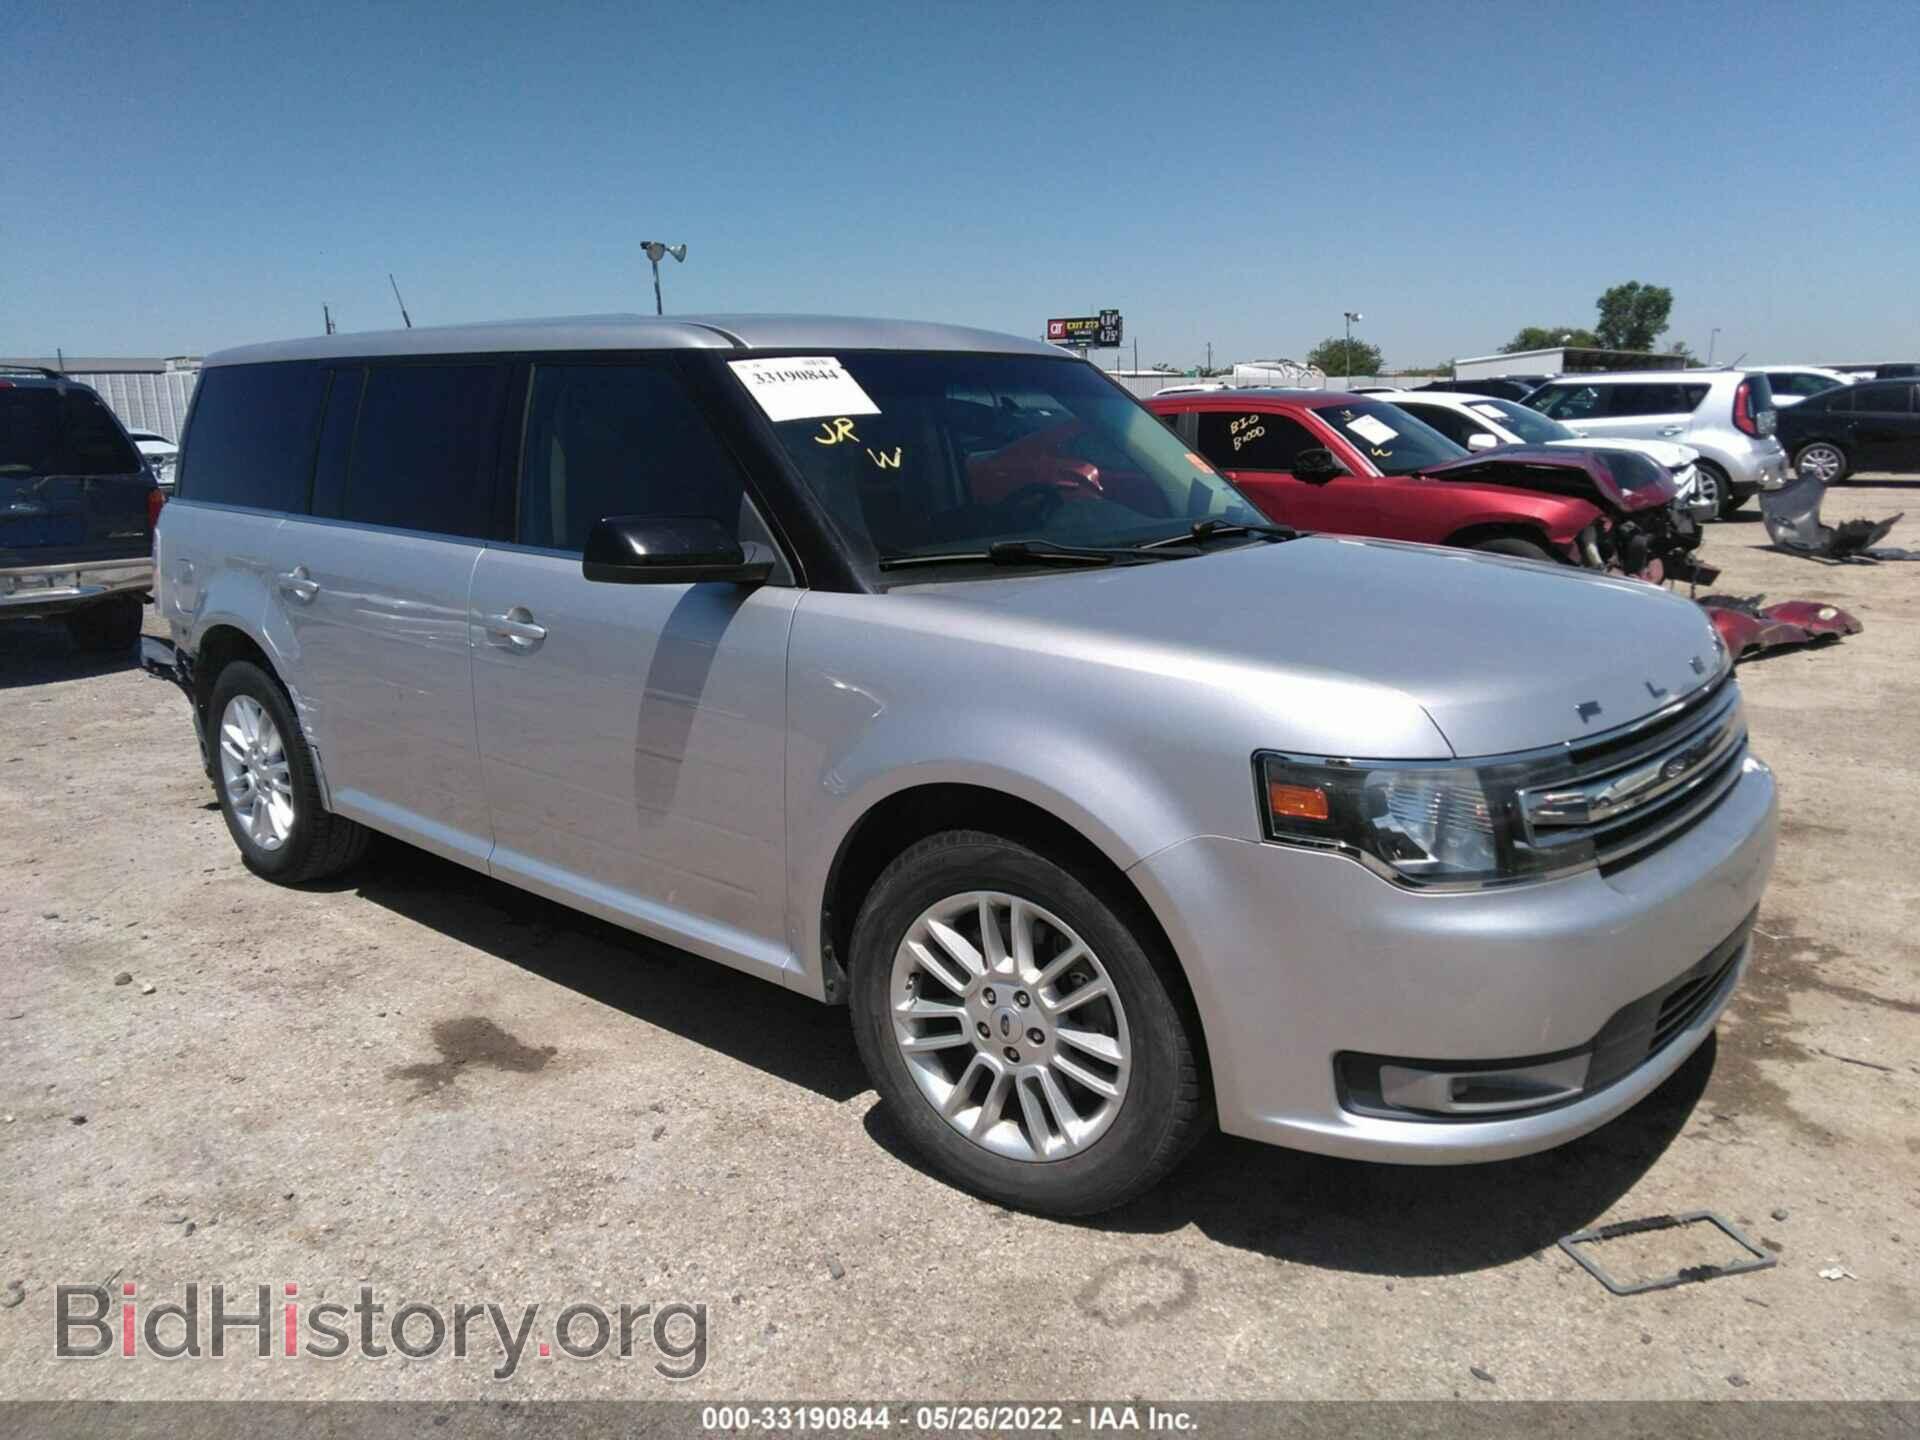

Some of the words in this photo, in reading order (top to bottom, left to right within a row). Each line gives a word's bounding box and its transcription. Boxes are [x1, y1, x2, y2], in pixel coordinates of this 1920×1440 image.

[753, 369, 839, 385] 33190844
[814, 417, 861, 445] JR
[866, 447, 903, 469] W
